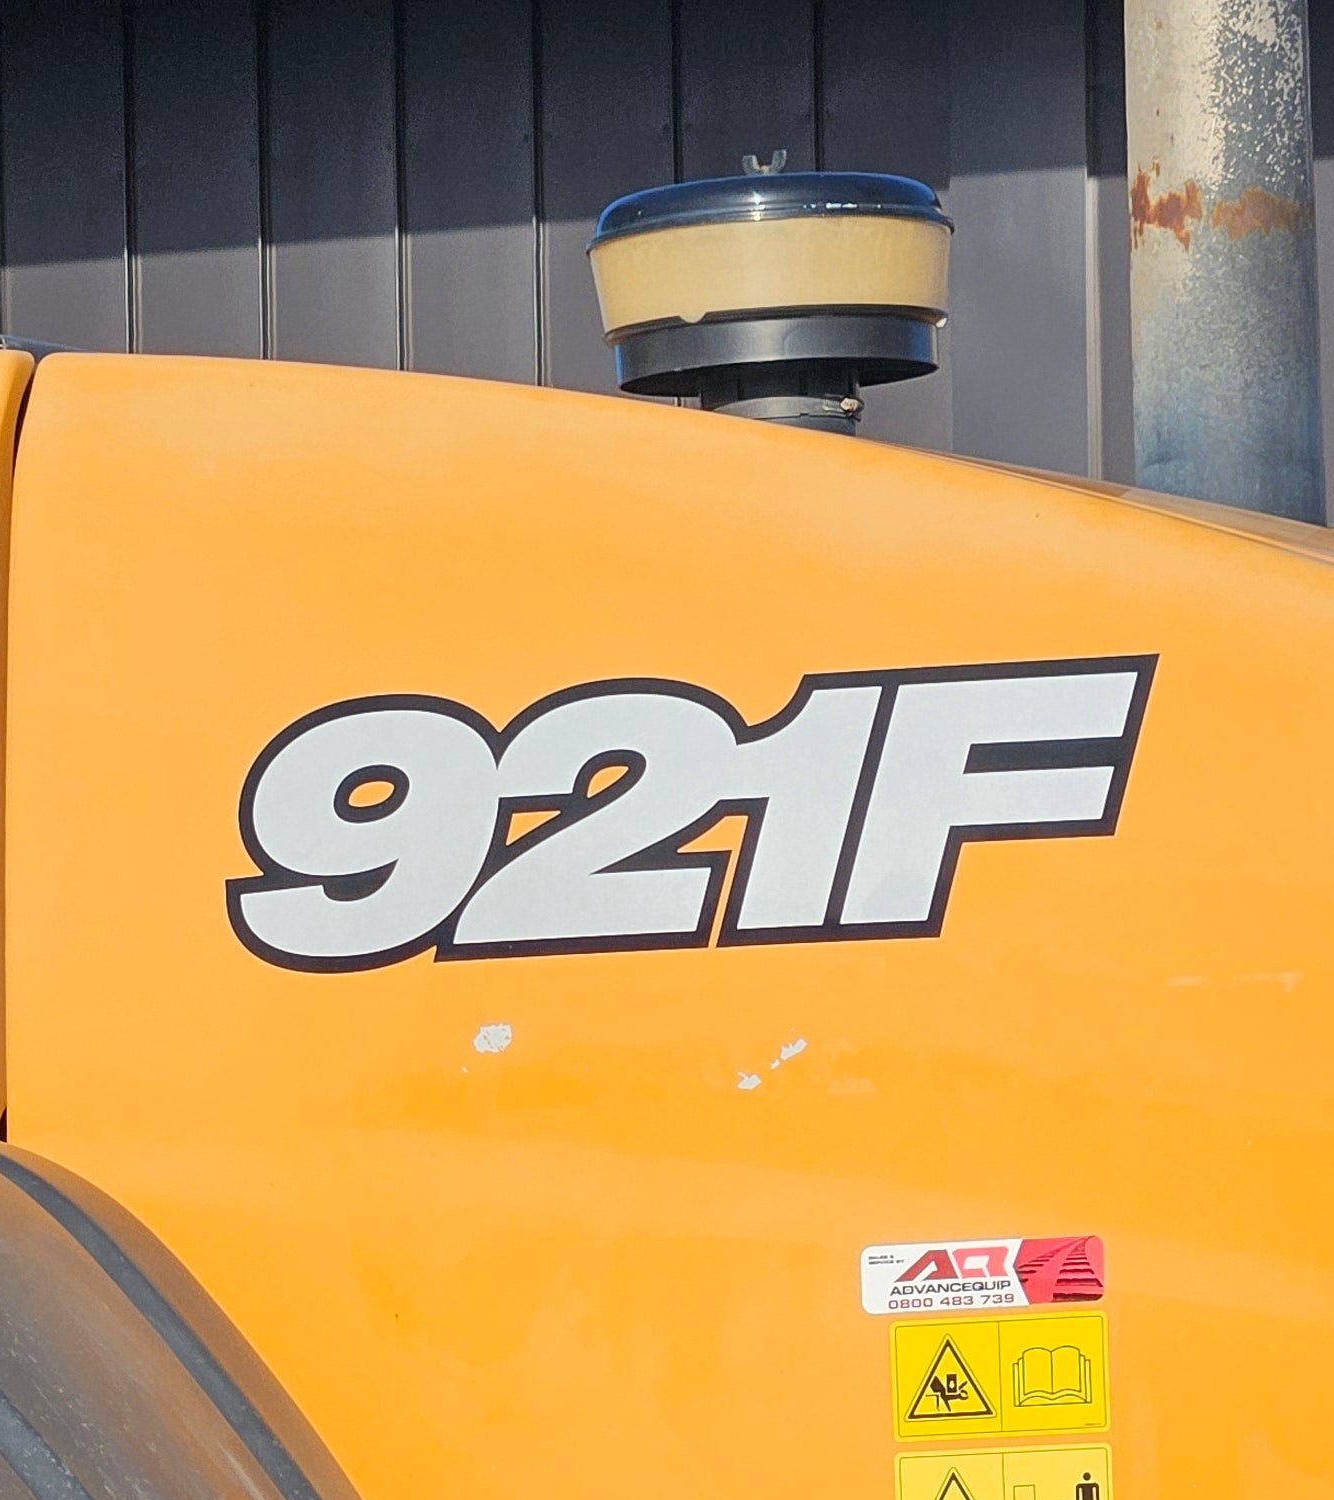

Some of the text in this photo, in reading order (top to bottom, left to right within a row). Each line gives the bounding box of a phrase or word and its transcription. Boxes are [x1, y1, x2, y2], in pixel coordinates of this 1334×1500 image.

[225, 653, 1160, 974] 921F
[890, 1280, 1011, 1297] ADVANCEQUIP
[888, 1293, 1015, 1310] 0800 483 739
